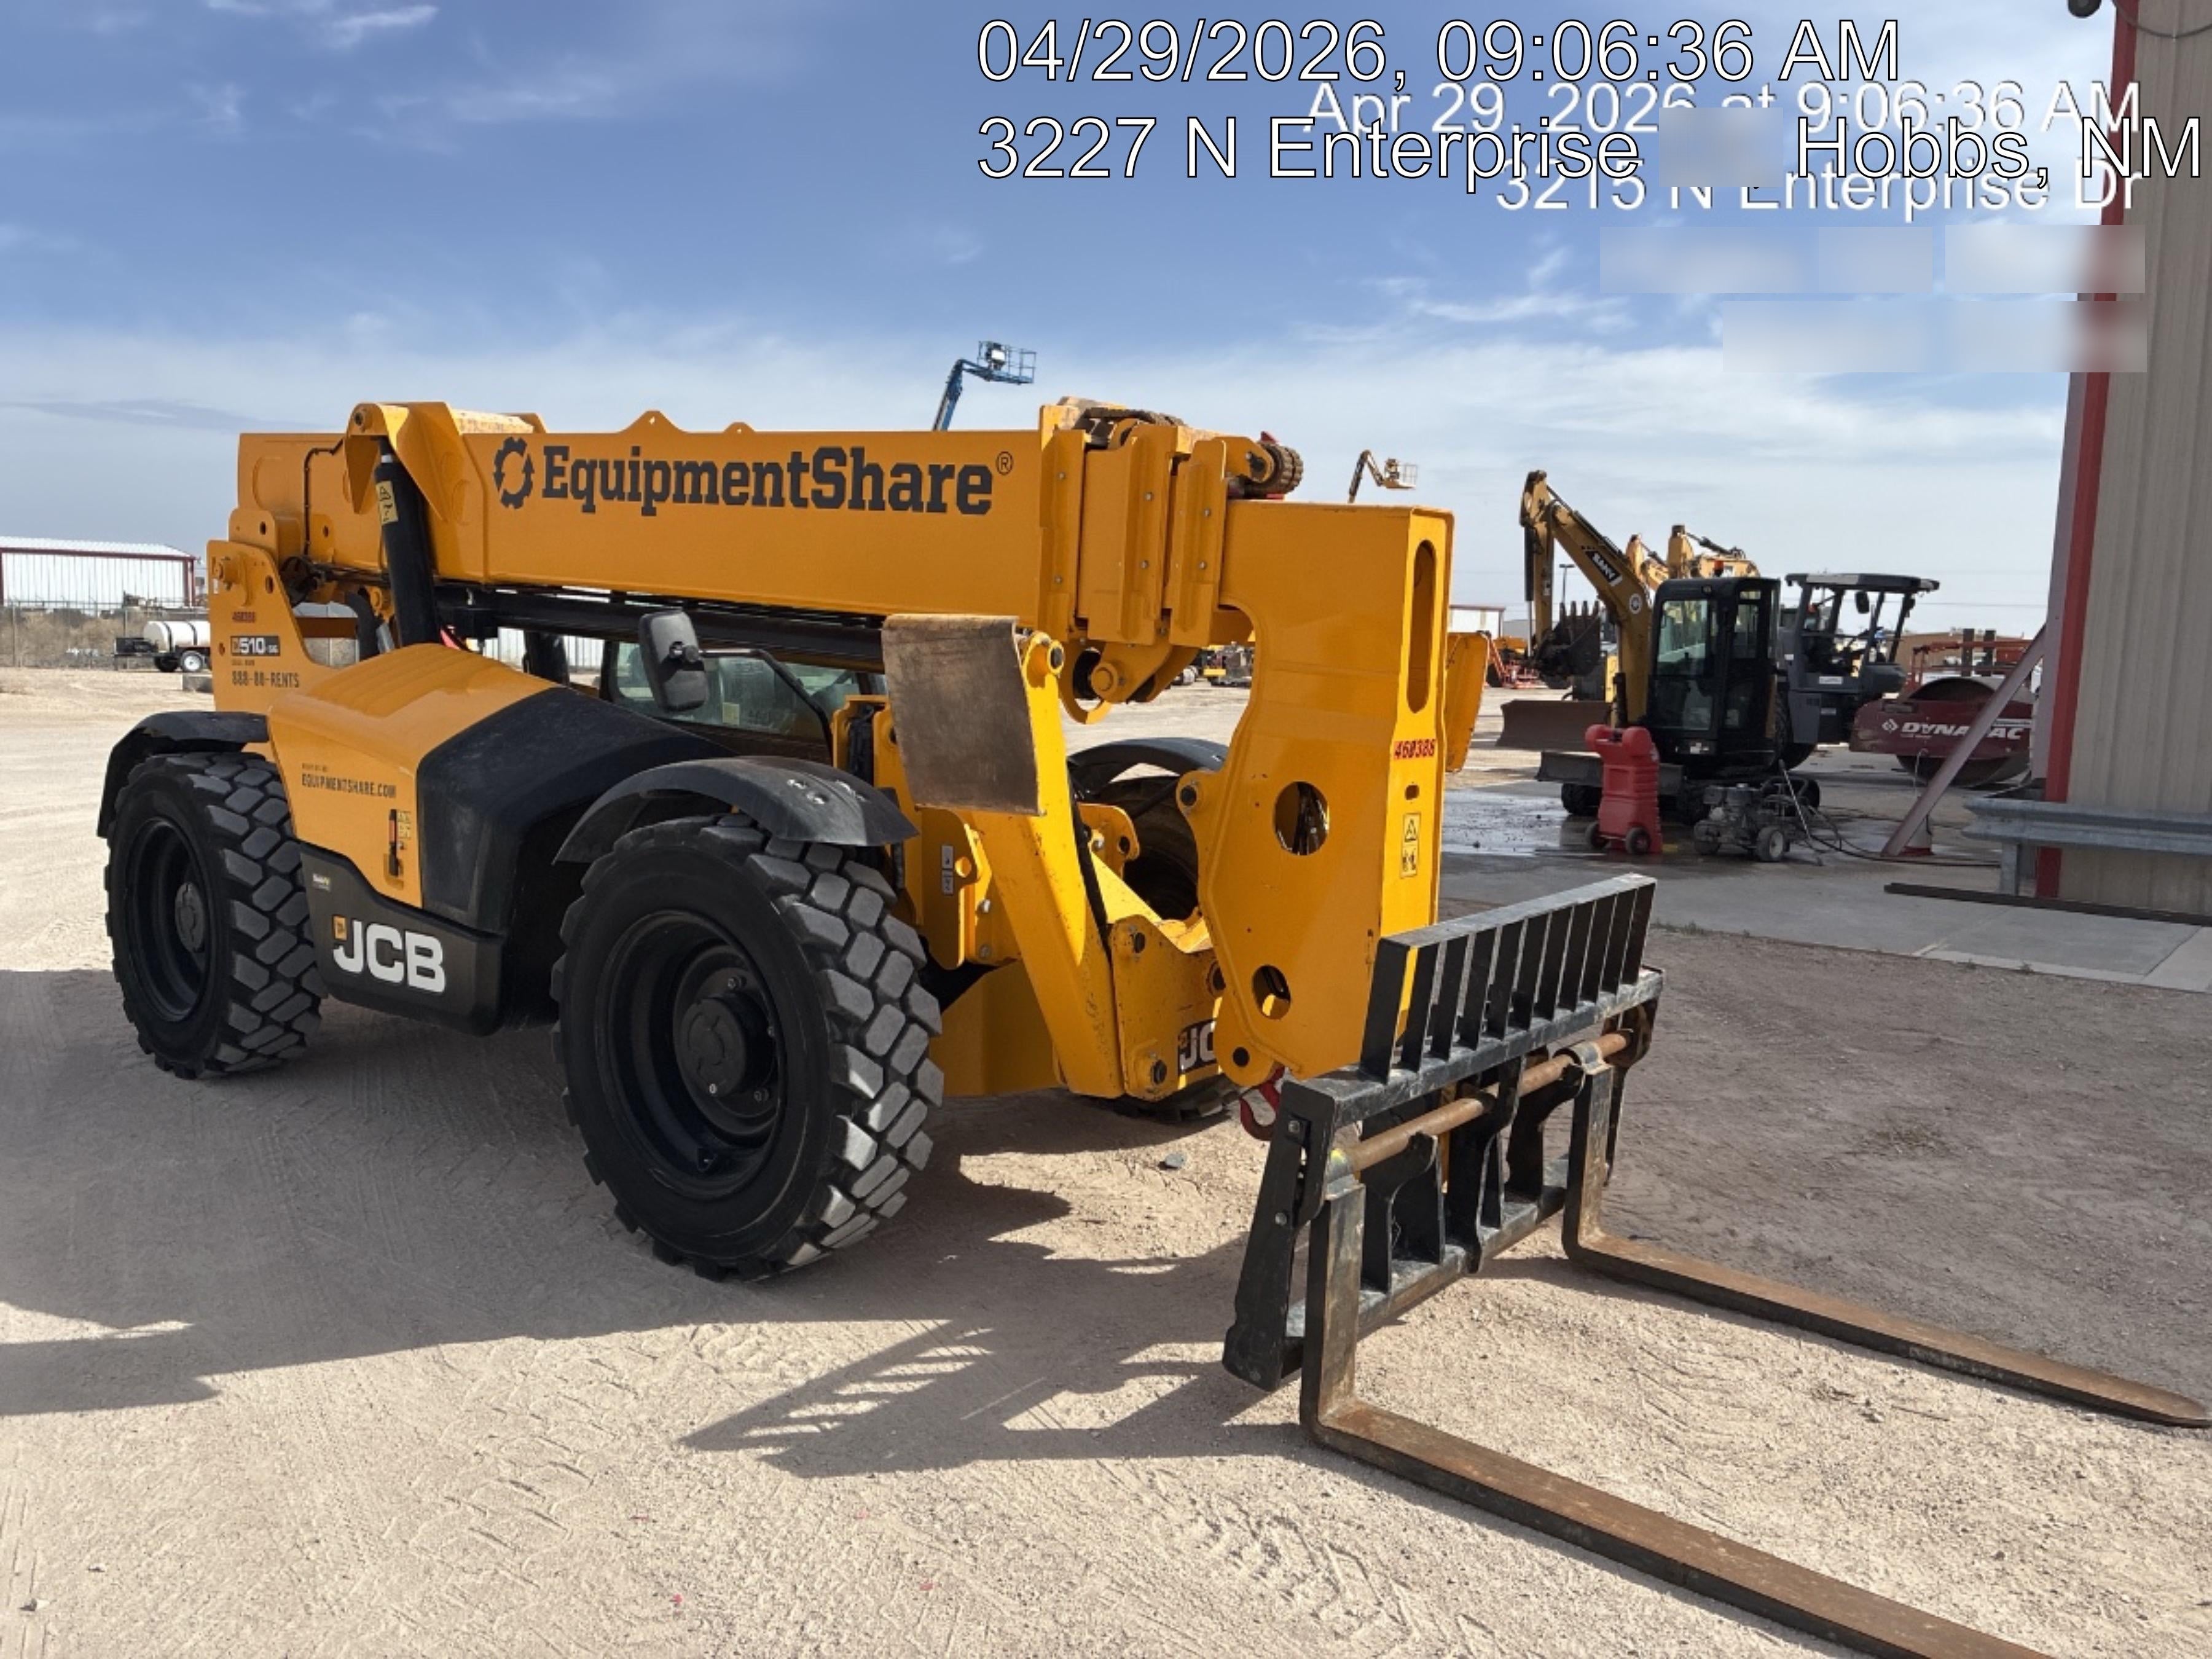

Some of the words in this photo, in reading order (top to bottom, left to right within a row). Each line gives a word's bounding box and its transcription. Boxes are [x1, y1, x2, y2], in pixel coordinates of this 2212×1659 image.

[1902, 721, 2025, 740] DYNAAC
[332, 919, 446, 993] JCB
[1180, 1021, 1216, 1070] JC
